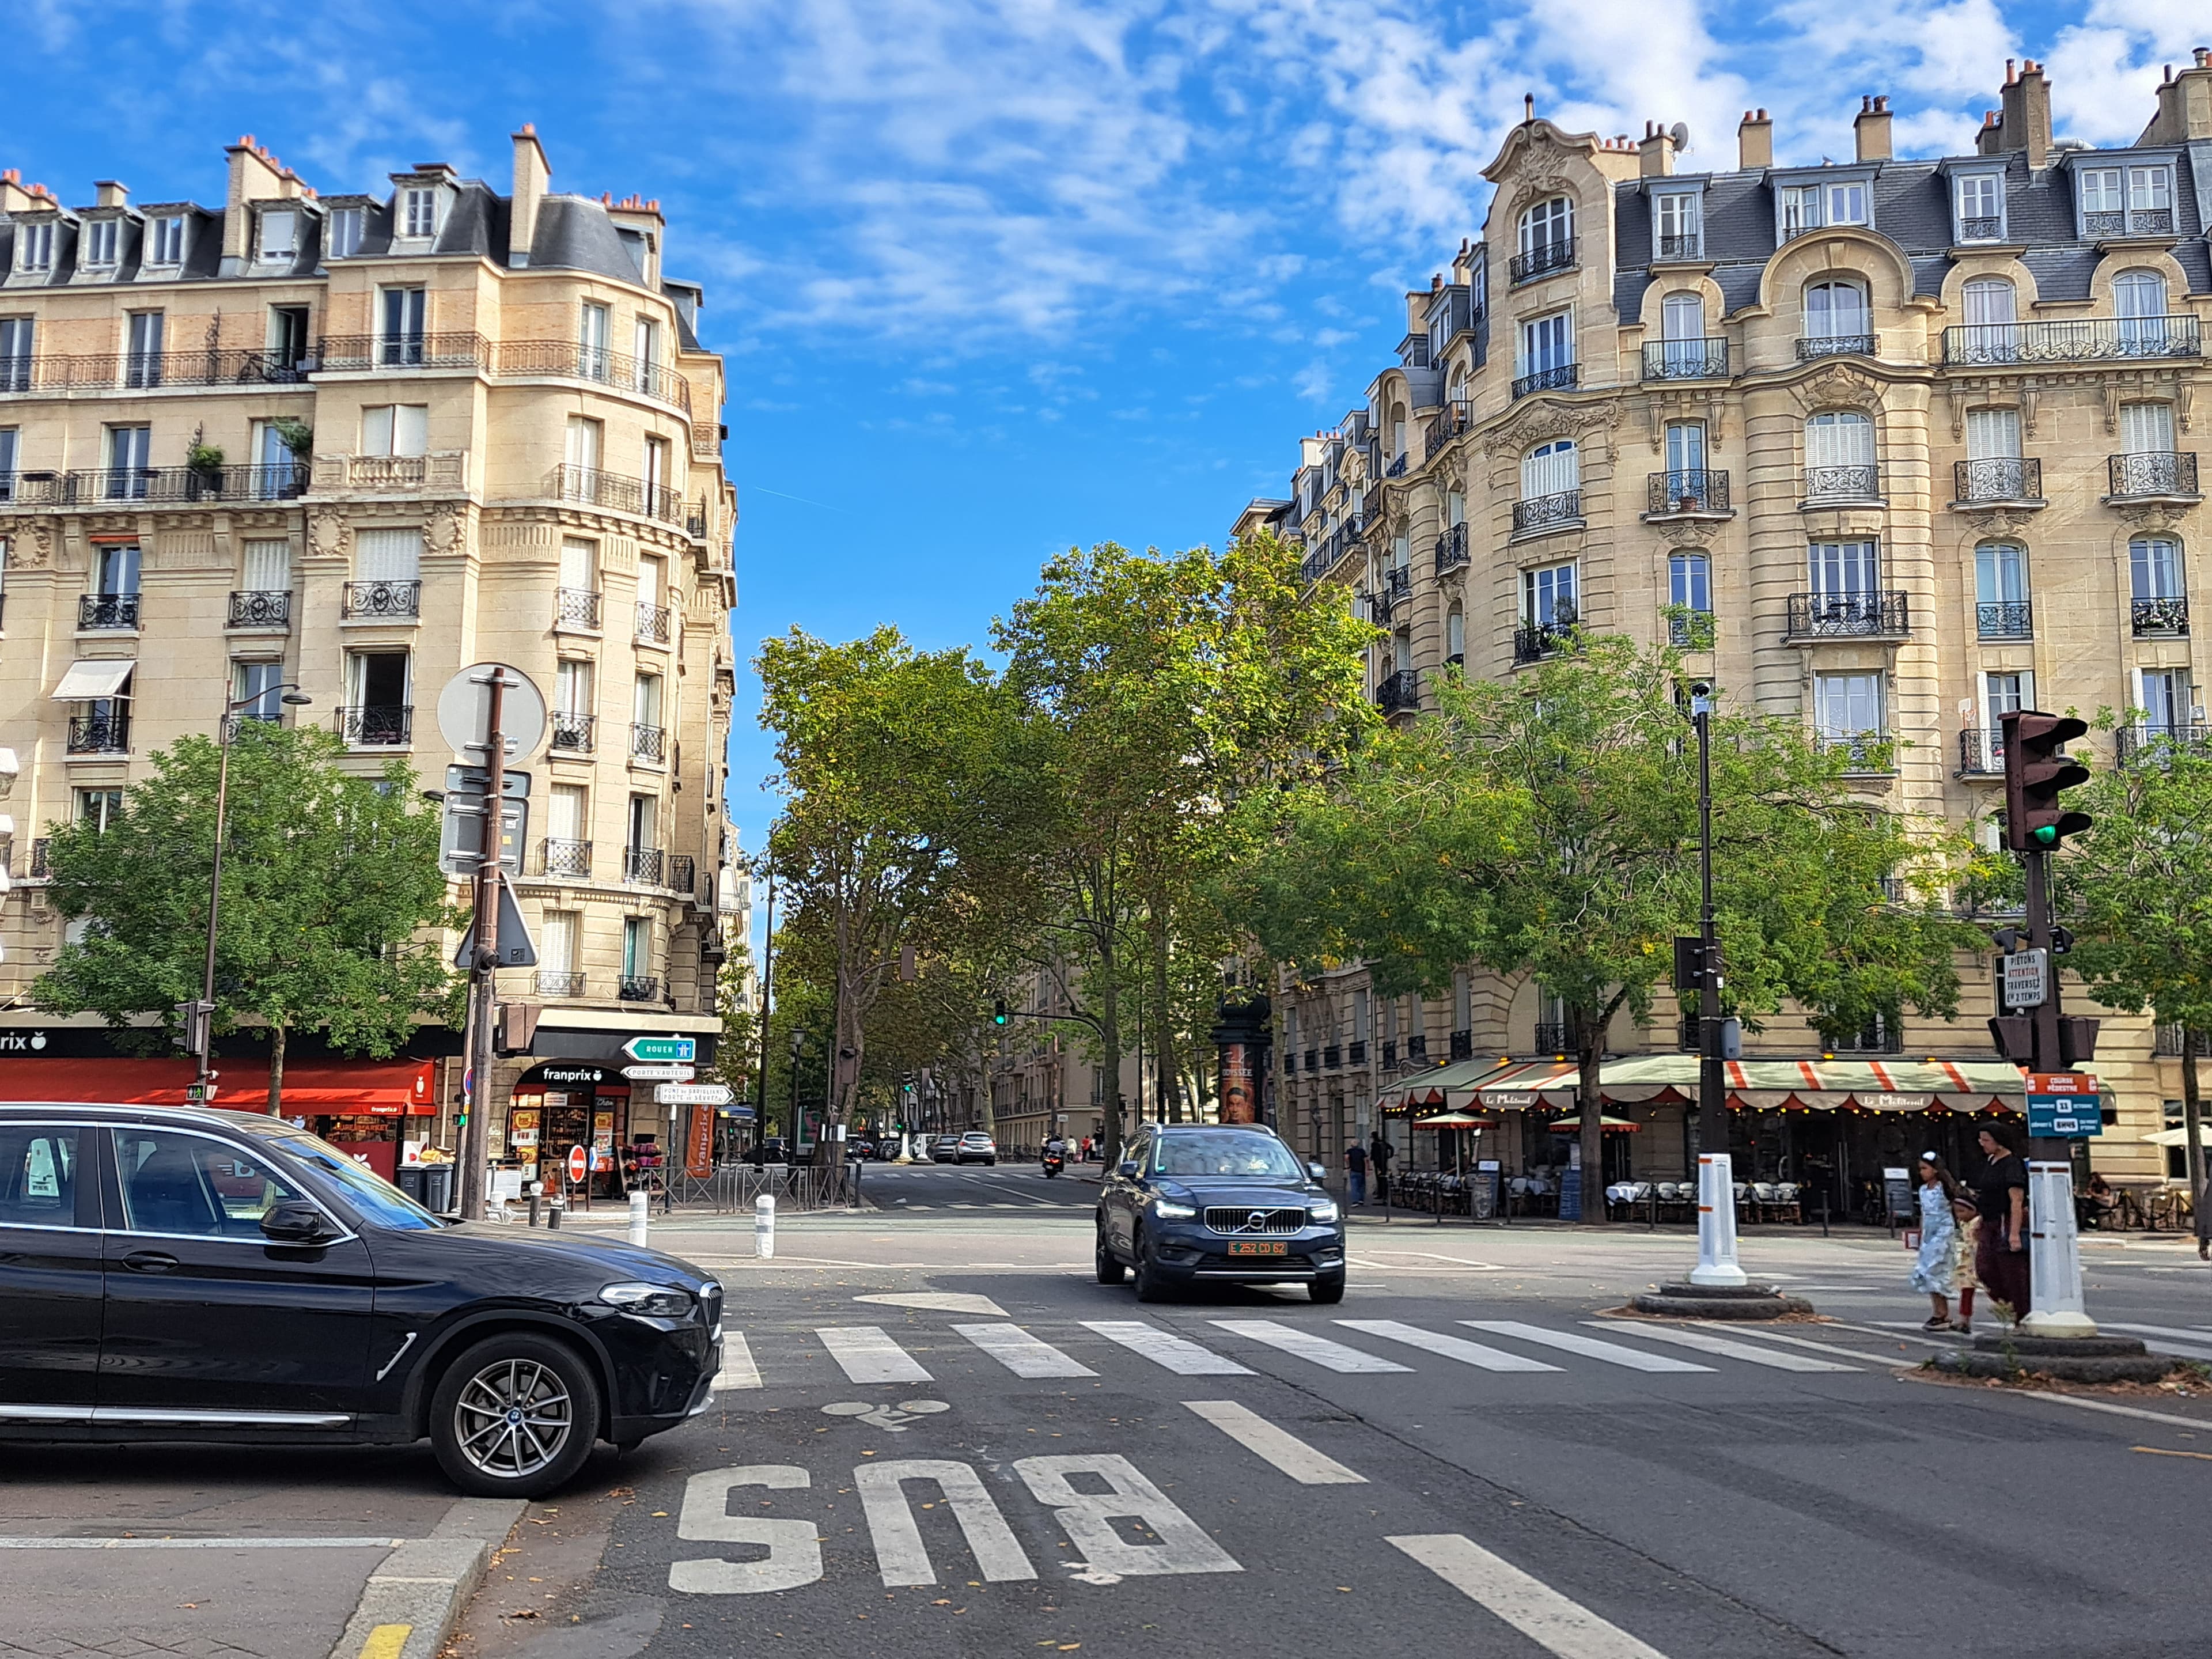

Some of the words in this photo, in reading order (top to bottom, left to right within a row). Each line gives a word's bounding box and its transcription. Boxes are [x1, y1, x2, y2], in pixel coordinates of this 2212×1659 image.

[2009, 967, 2039, 977] ATTENTION
[2007, 978, 2040, 990] TRAVERSEZ
[2016, 993, 2020, 1002] 2
[2022, 991, 2040, 1001] TEMPS
[543, 1068, 591, 1082] franprix
[695, 1113, 709, 1172] franprix
[1239, 1243, 1256, 1253] 252
[1259, 1243, 1270, 1253] CD
[668, 1453, 1245, 1594] BUS
